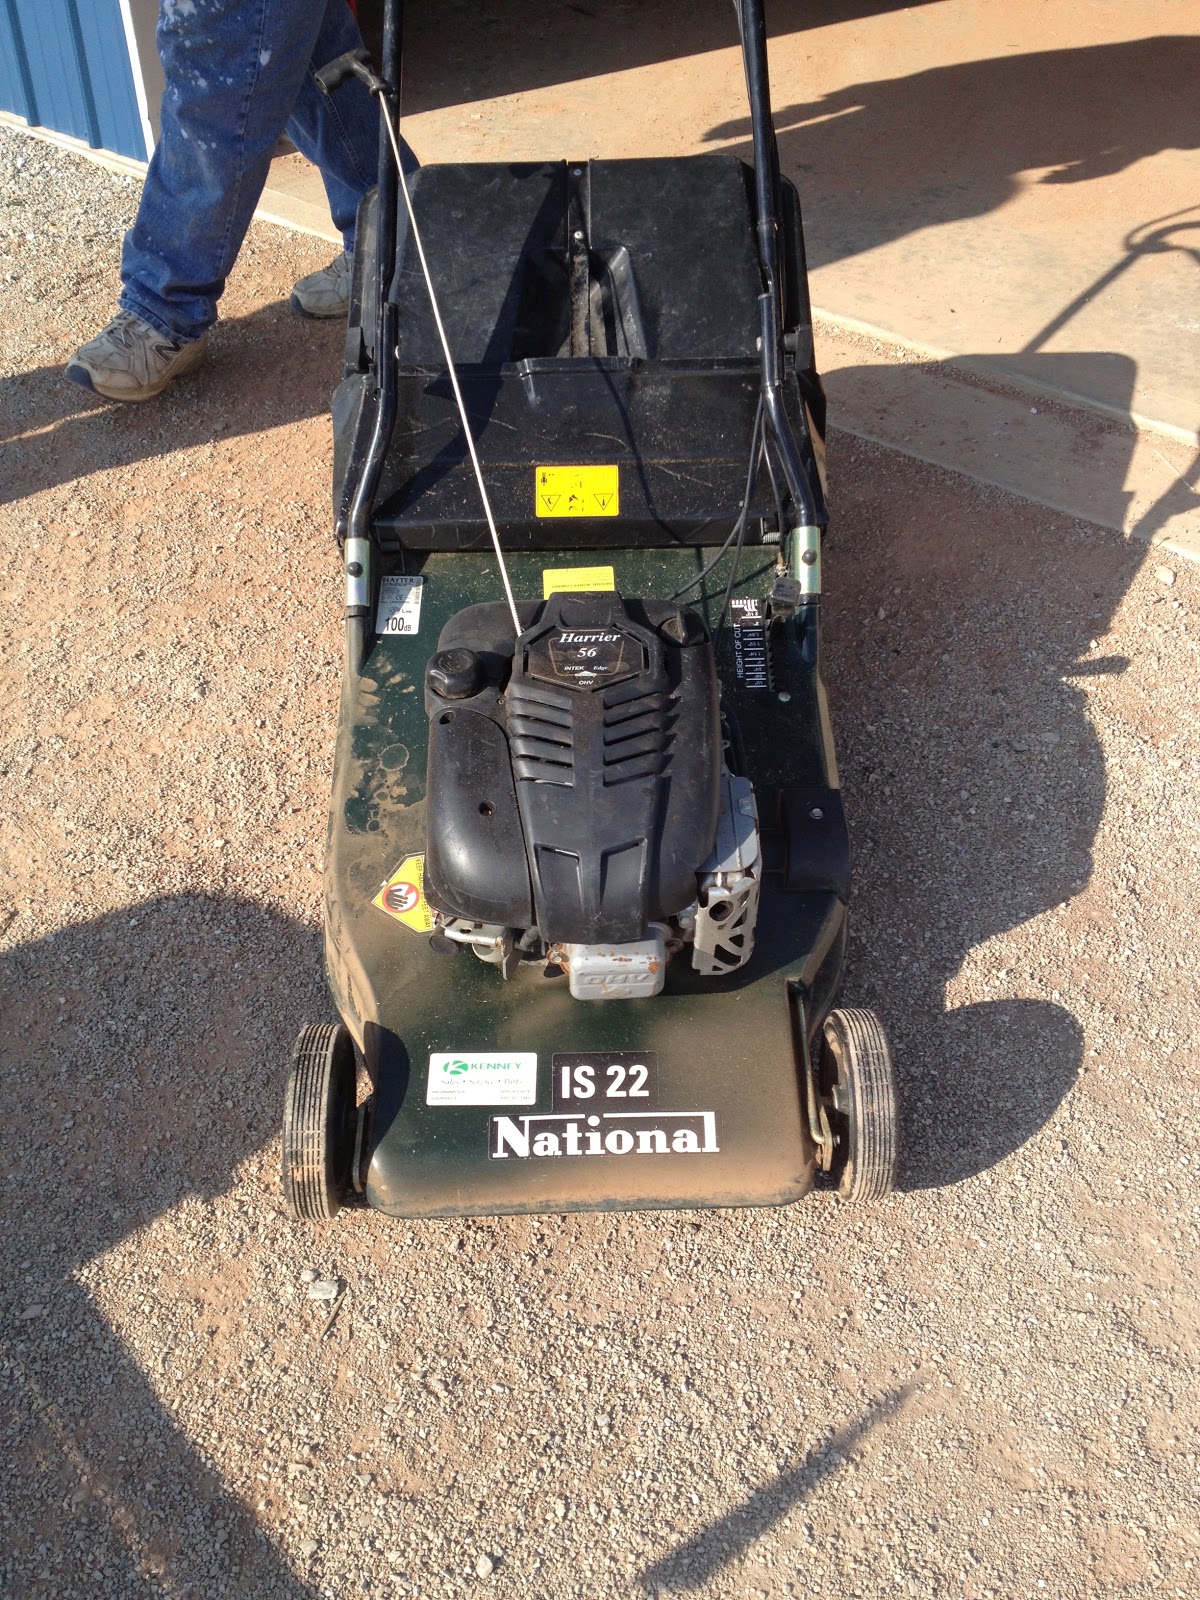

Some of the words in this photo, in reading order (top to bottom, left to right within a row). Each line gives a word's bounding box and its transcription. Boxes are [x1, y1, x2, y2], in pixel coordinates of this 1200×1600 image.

[733, 623, 741, 638] CUT
[559, 632, 621, 643] Harrier
[735, 639, 742, 650] OF
[577, 647, 597, 657] 56
[736, 651, 744, 678] HEIGHT
[415, 859, 423, 871] KEEP
[471, 1062, 522, 1070] KENNEY
[561, 1065, 596, 1099] IS
[606, 1064, 650, 1098] 22
[492, 1111, 720, 1158] National
